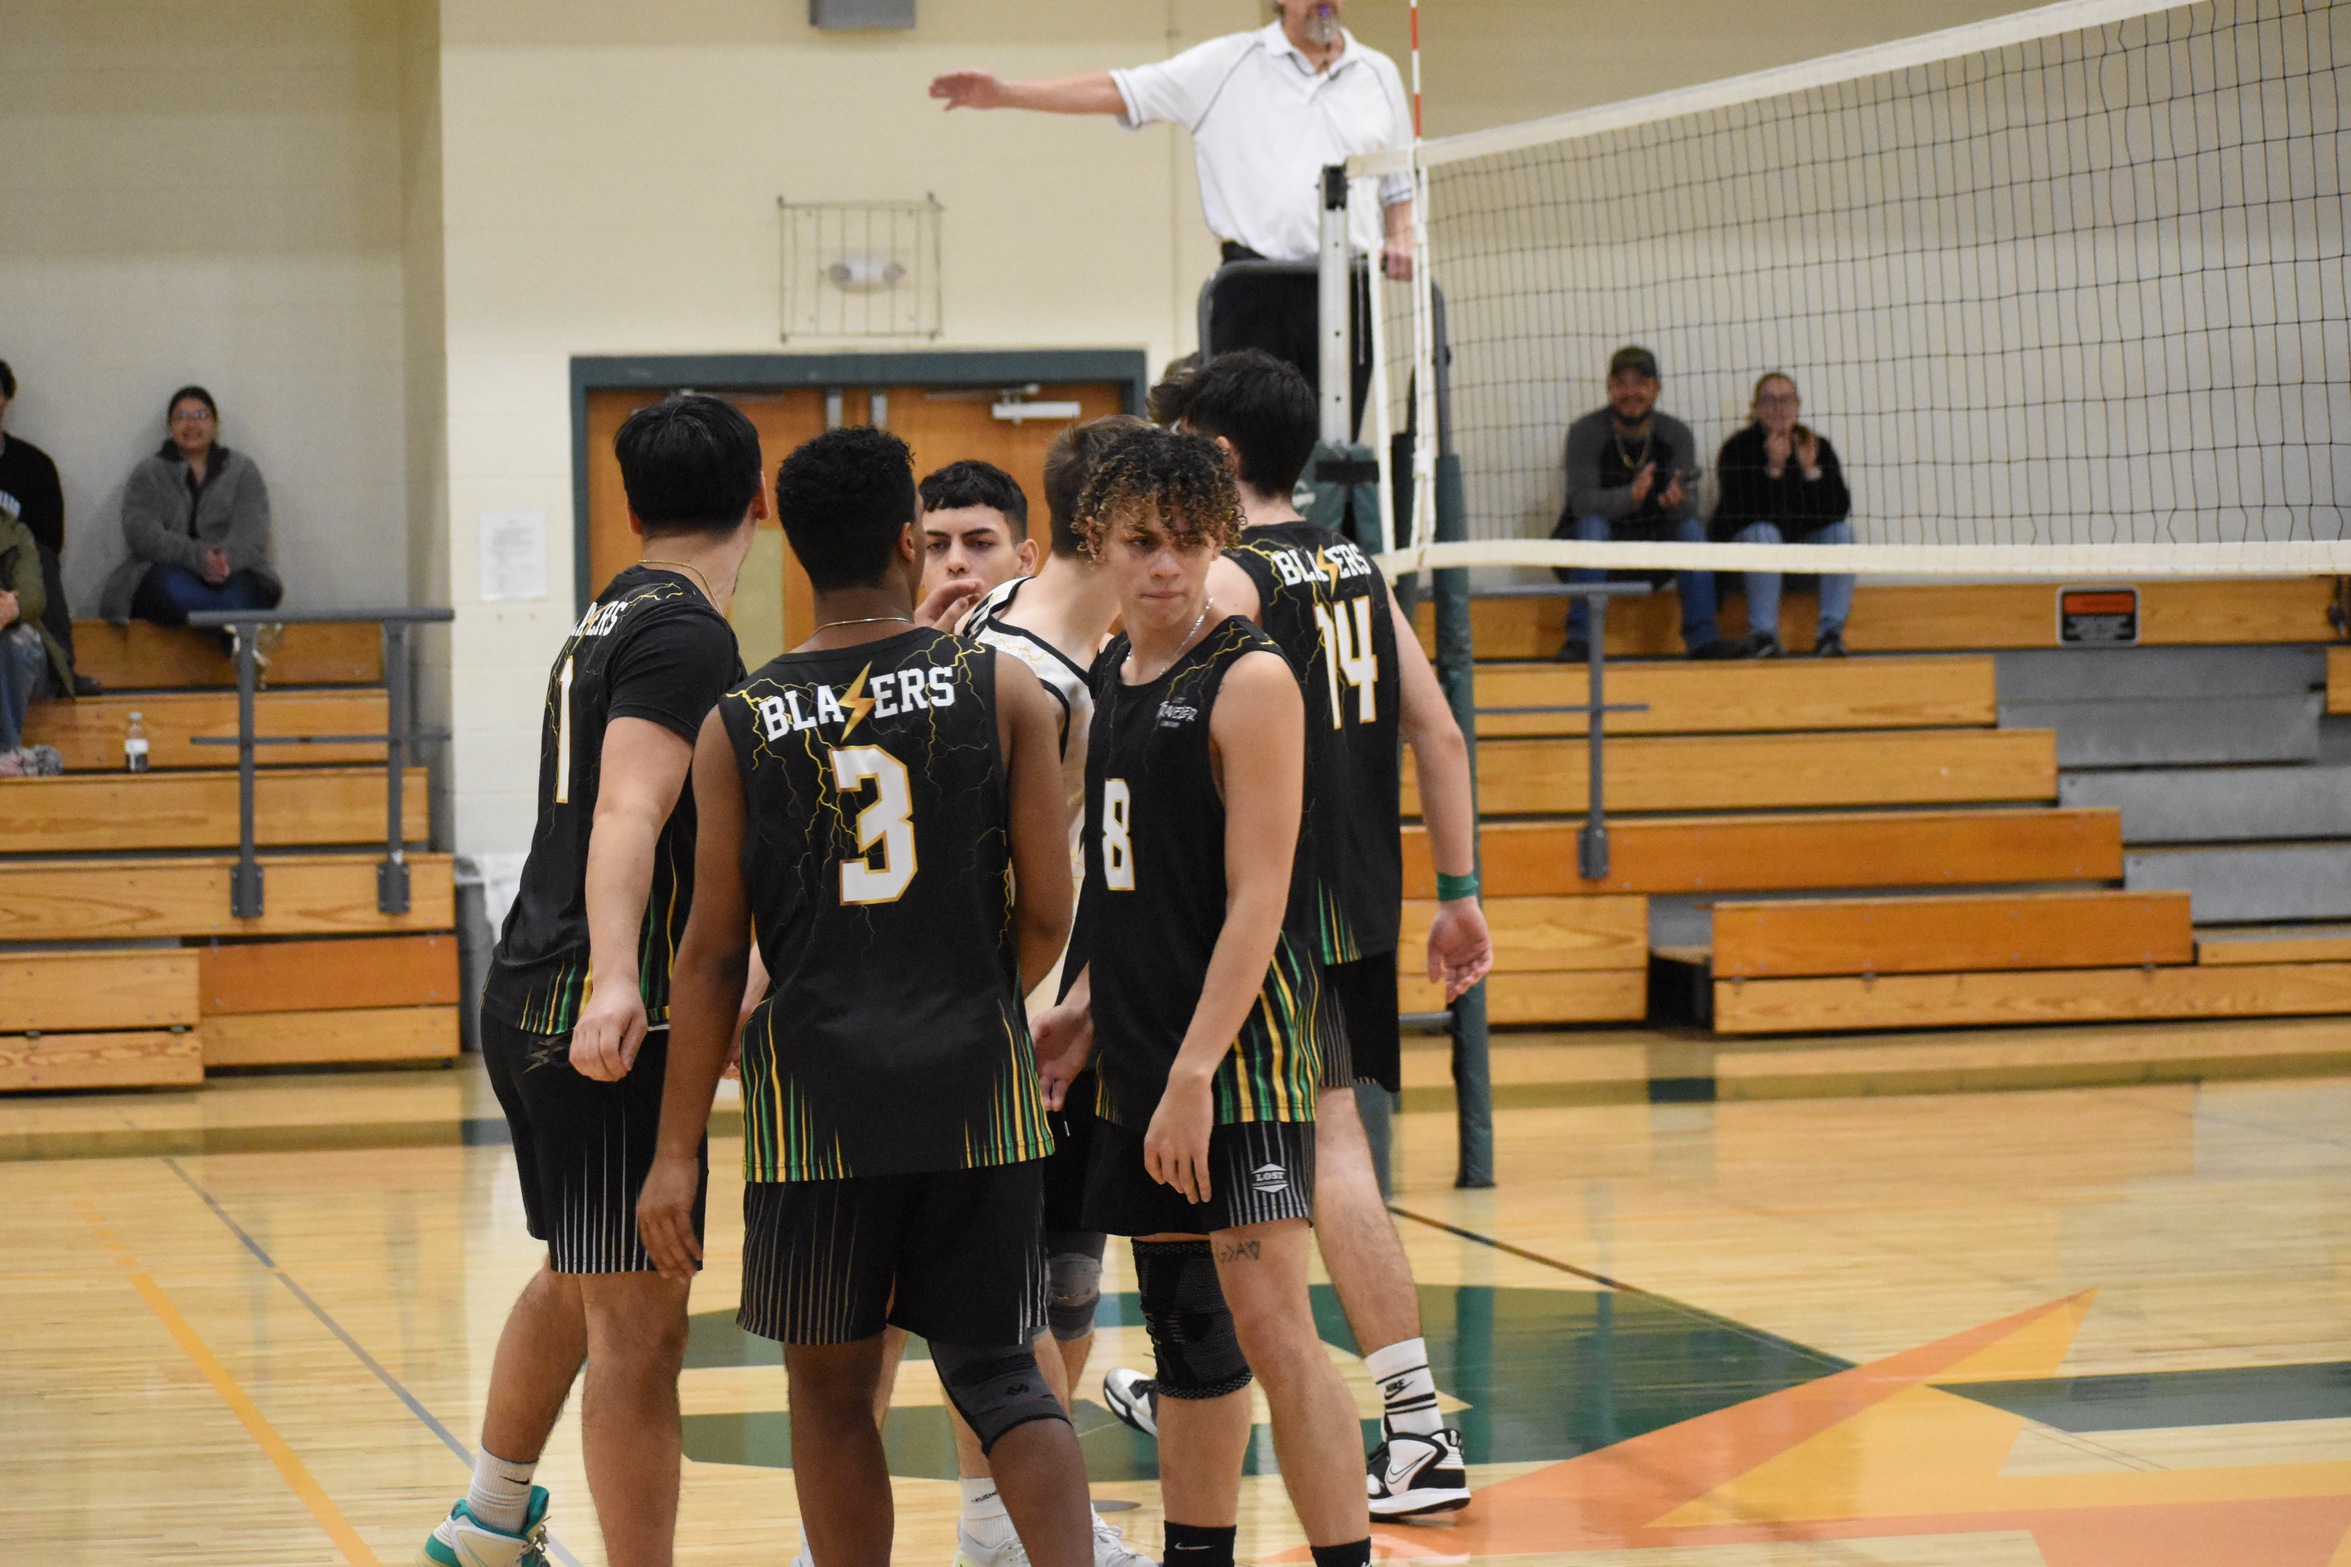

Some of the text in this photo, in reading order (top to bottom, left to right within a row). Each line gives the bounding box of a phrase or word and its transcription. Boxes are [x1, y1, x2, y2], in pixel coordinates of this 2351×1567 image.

[556, 655, 573, 803] 1
[1313, 596, 1378, 729] 14
[828, 744, 918, 906] 3
[1102, 778, 1135, 891] 8
[1255, 1171, 1285, 1181] LOST
